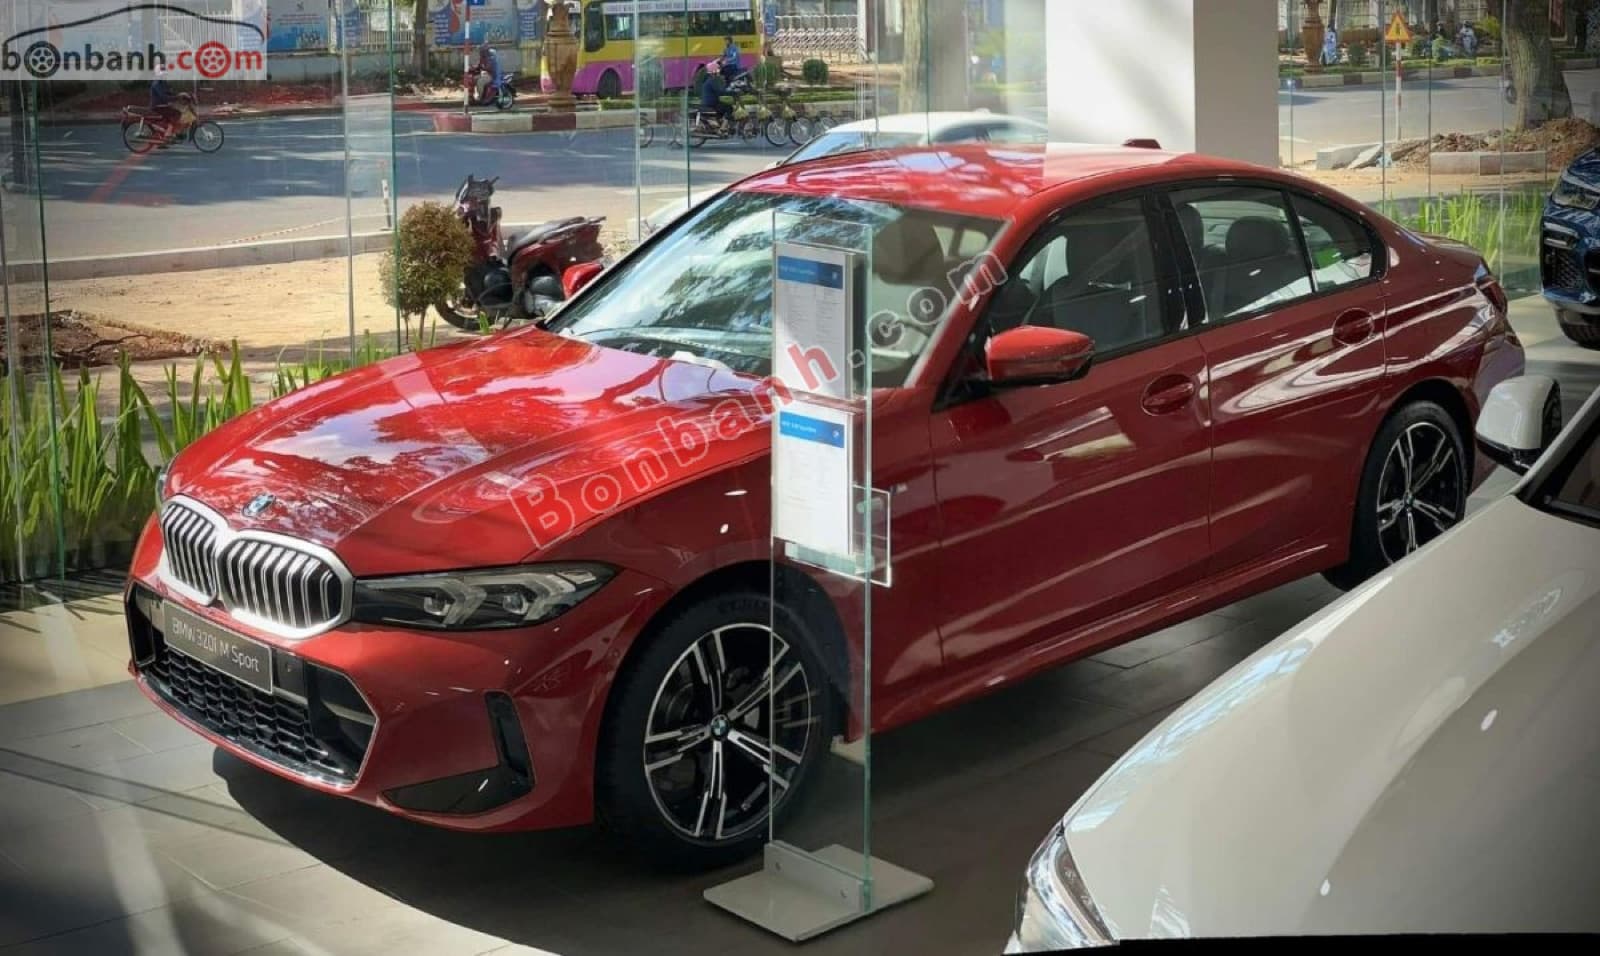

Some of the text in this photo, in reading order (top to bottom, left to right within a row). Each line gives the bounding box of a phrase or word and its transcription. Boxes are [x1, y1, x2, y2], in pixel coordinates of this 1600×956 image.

[172, 617, 260, 672] BMW 320i M Sport
